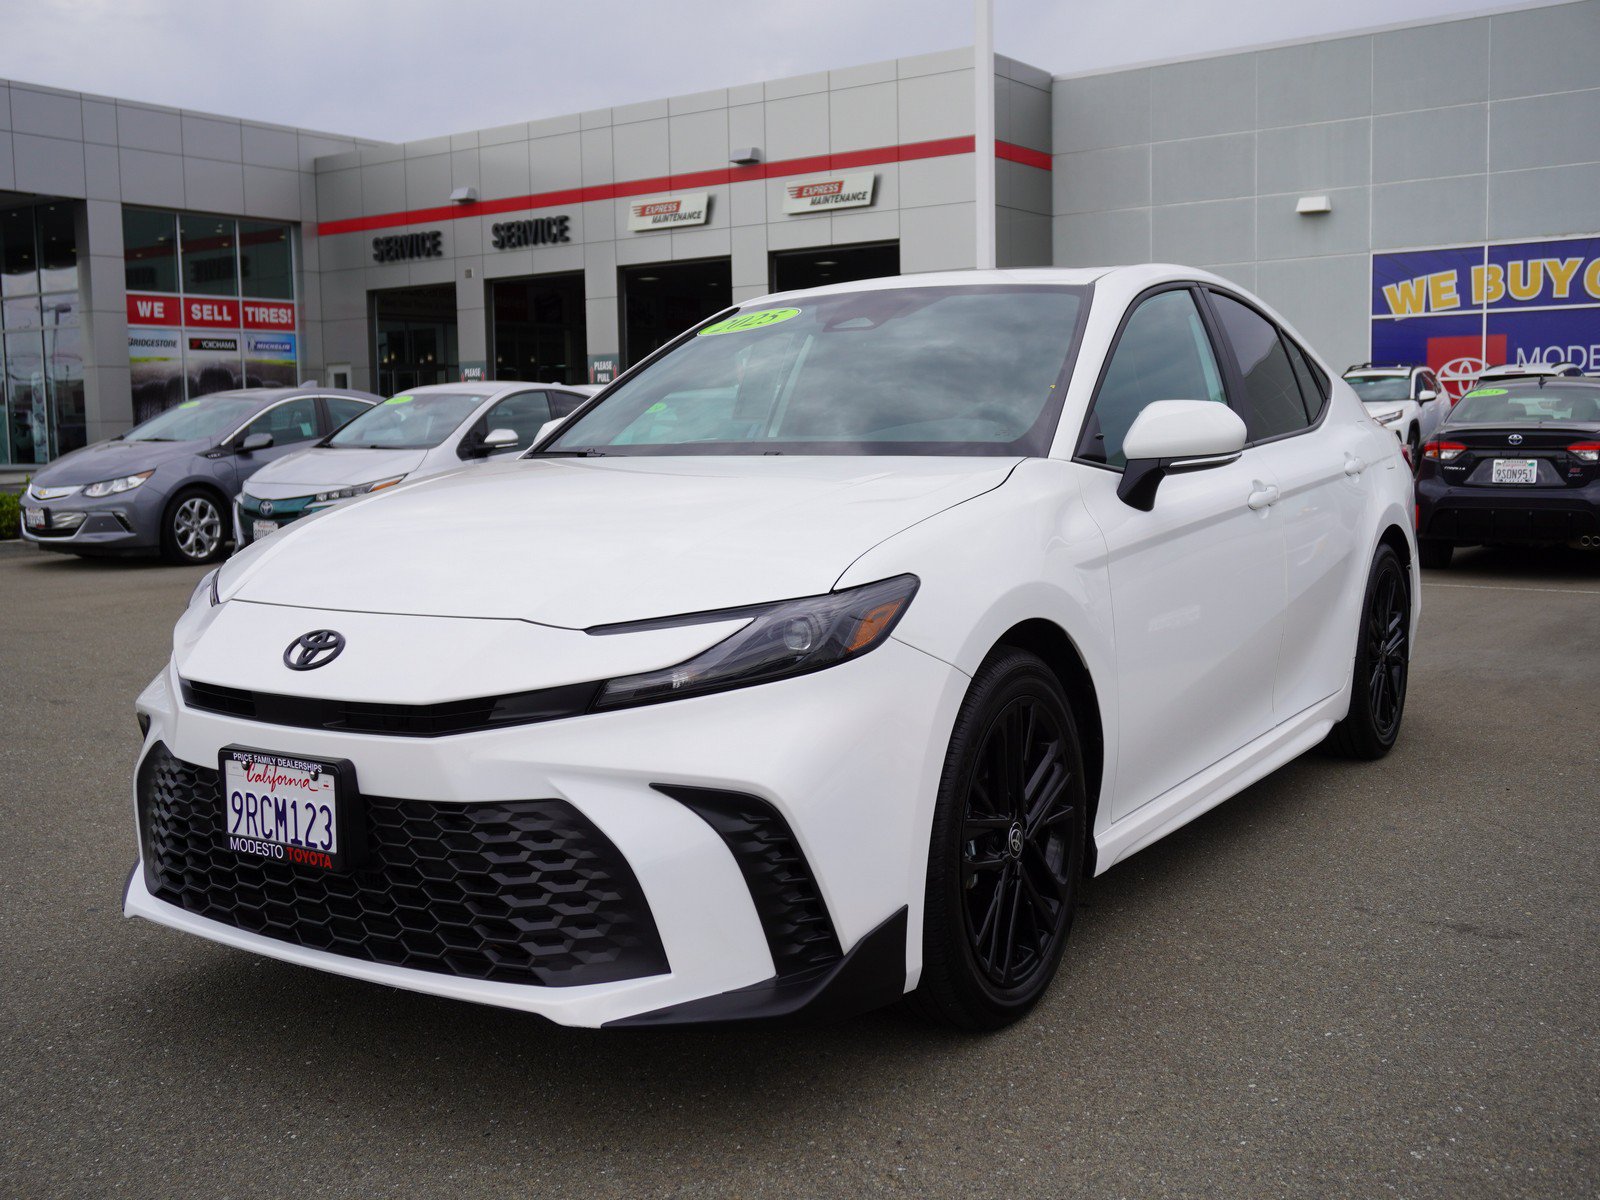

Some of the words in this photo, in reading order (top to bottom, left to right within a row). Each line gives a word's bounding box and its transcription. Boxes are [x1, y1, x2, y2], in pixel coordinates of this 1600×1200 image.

[802, 182, 841, 197] EXPRESS
[810, 191, 868, 206] MAINTENANCE
[644, 201, 678, 215] EXPRESS
[652, 210, 703, 225] MAINTENANCE
[491, 215, 571, 250] SERVICE
[372, 231, 443, 263] SERVICE
[1382, 269, 1461, 321] WE
[1471, 257, 1585, 305] BUY
[137, 301, 165, 318] WE
[191, 304, 232, 321] SELL
[244, 306, 293, 324] TIRES!
[201, 339, 236, 350] YOKOHAMA
[256, 343, 292, 351] MICHELIN
[464, 367, 481, 378] PLEASE
[593, 361, 613, 371] PLEASE
[597, 373, 610, 383] PULL
[233, 752, 252, 763] PRICE
[254, 754, 276, 766] FAMILY
[277, 758, 322, 773] DEALERSHIPS
[246, 762, 318, 793] California
[231, 790, 333, 851] 9RCM123
[230, 837, 284, 859] MODESTO
[285, 847, 333, 869] TOYOTA
